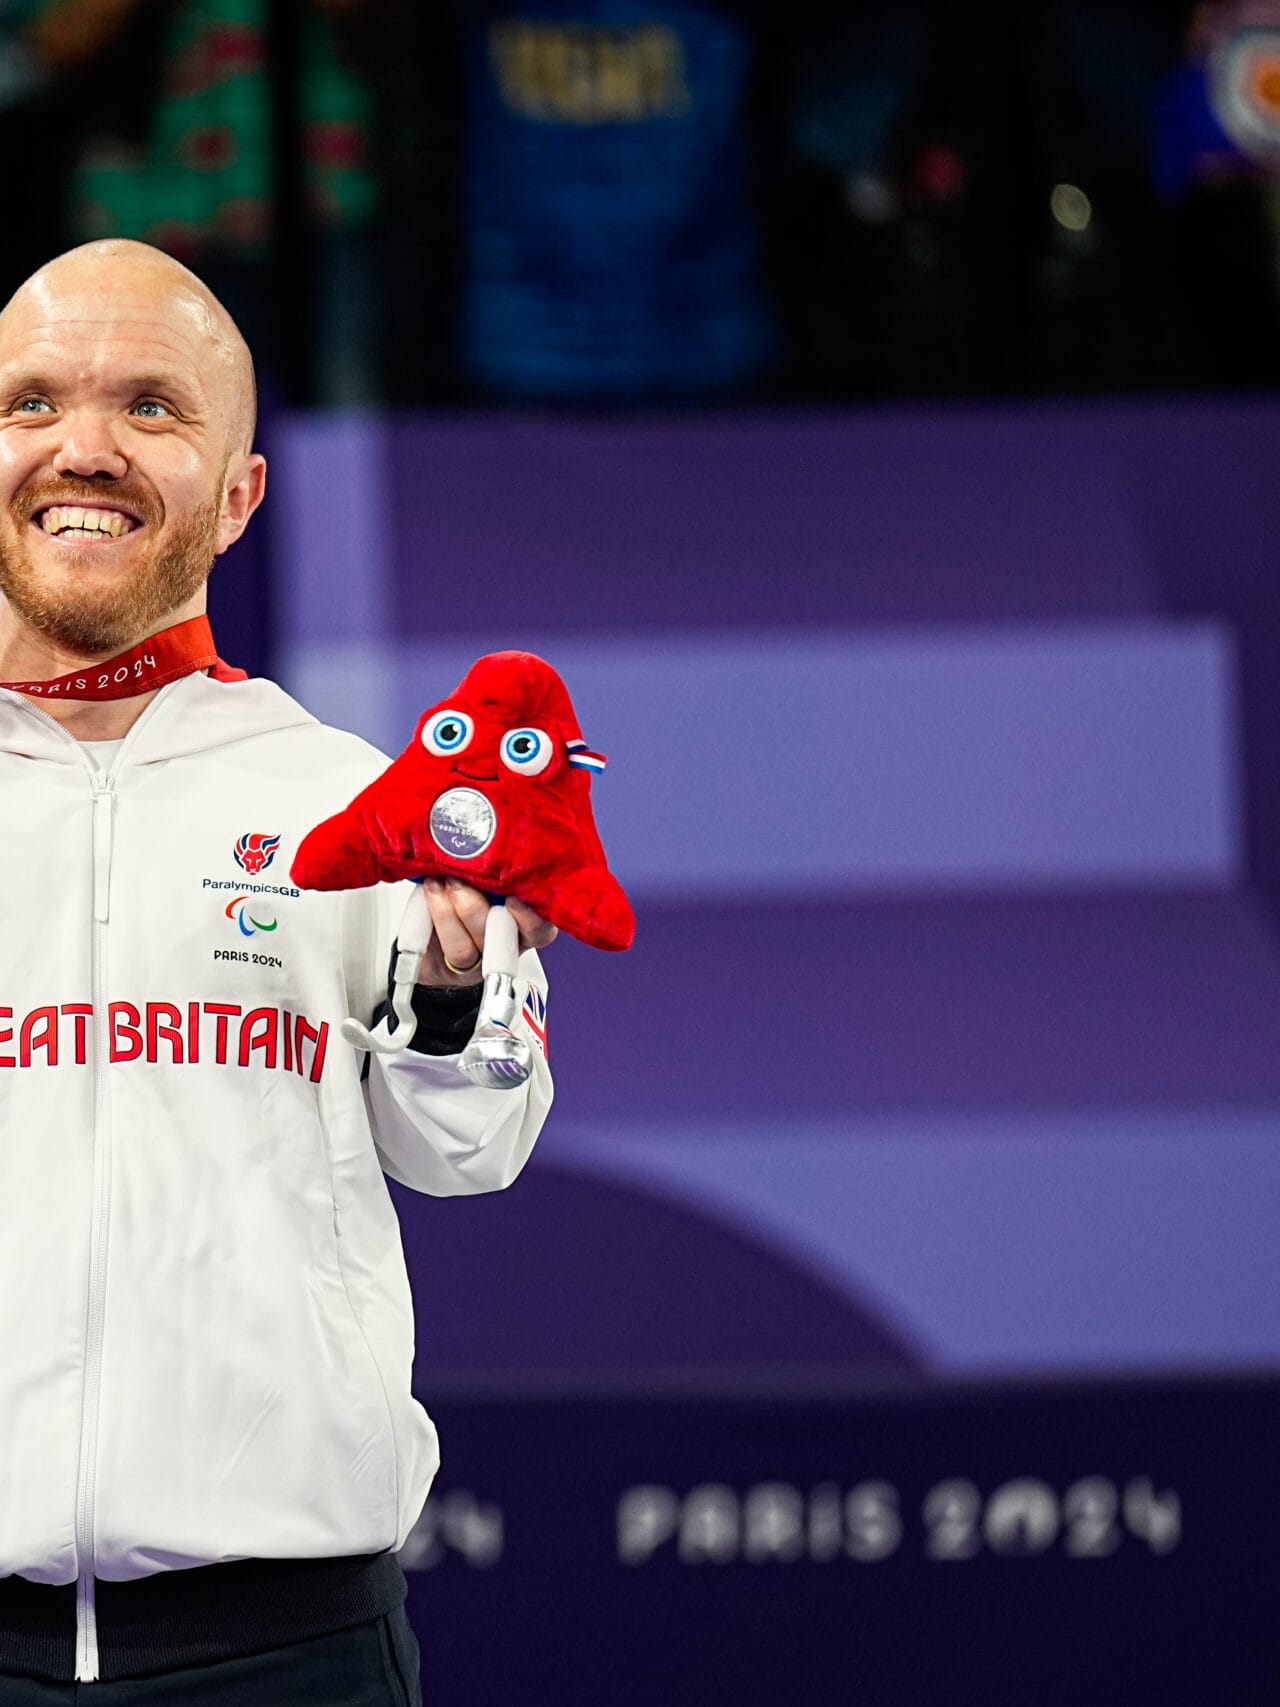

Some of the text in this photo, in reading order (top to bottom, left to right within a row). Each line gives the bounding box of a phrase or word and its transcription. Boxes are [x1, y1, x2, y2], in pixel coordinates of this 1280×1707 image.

[97, 654, 156, 689] 2024
[202, 878, 300, 898] ParalympicsGB
[252, 953, 282, 969] 2024
[107, 1001, 329, 1084] BRITAIN
[922, 1474, 1182, 1561] 2024
